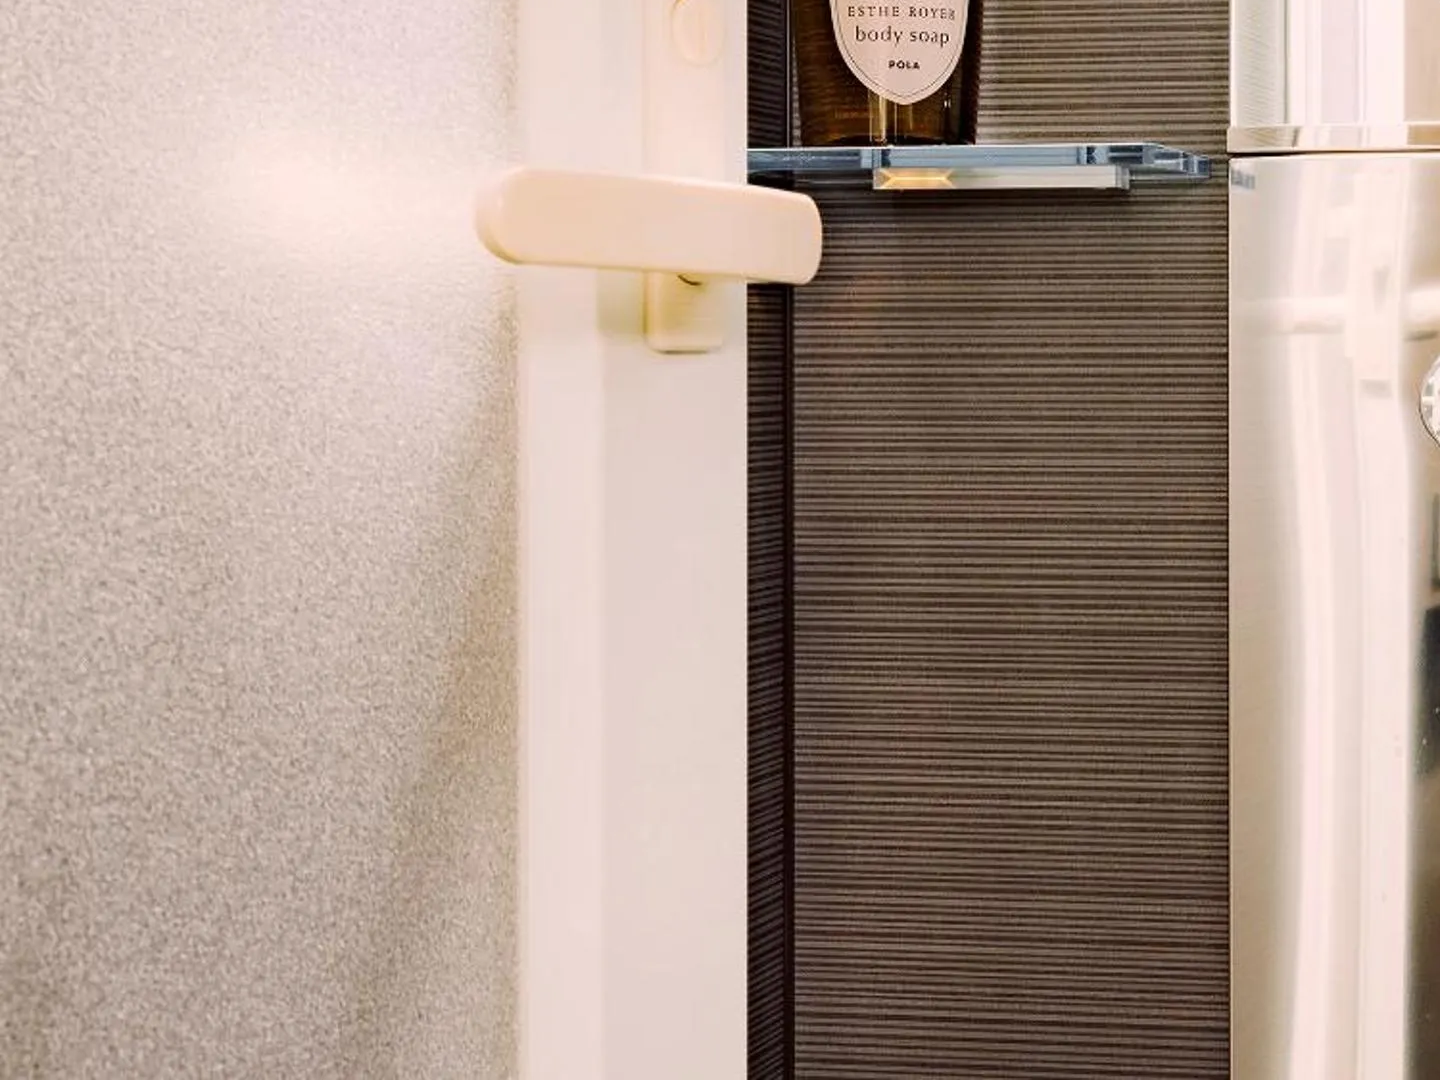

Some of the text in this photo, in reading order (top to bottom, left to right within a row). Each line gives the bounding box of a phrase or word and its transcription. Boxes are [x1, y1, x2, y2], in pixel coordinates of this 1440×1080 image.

[847, 6, 956, 21] ESTHE ROYER
[855, 25, 950, 48] body soap
[888, 59, 920, 70] POLA
